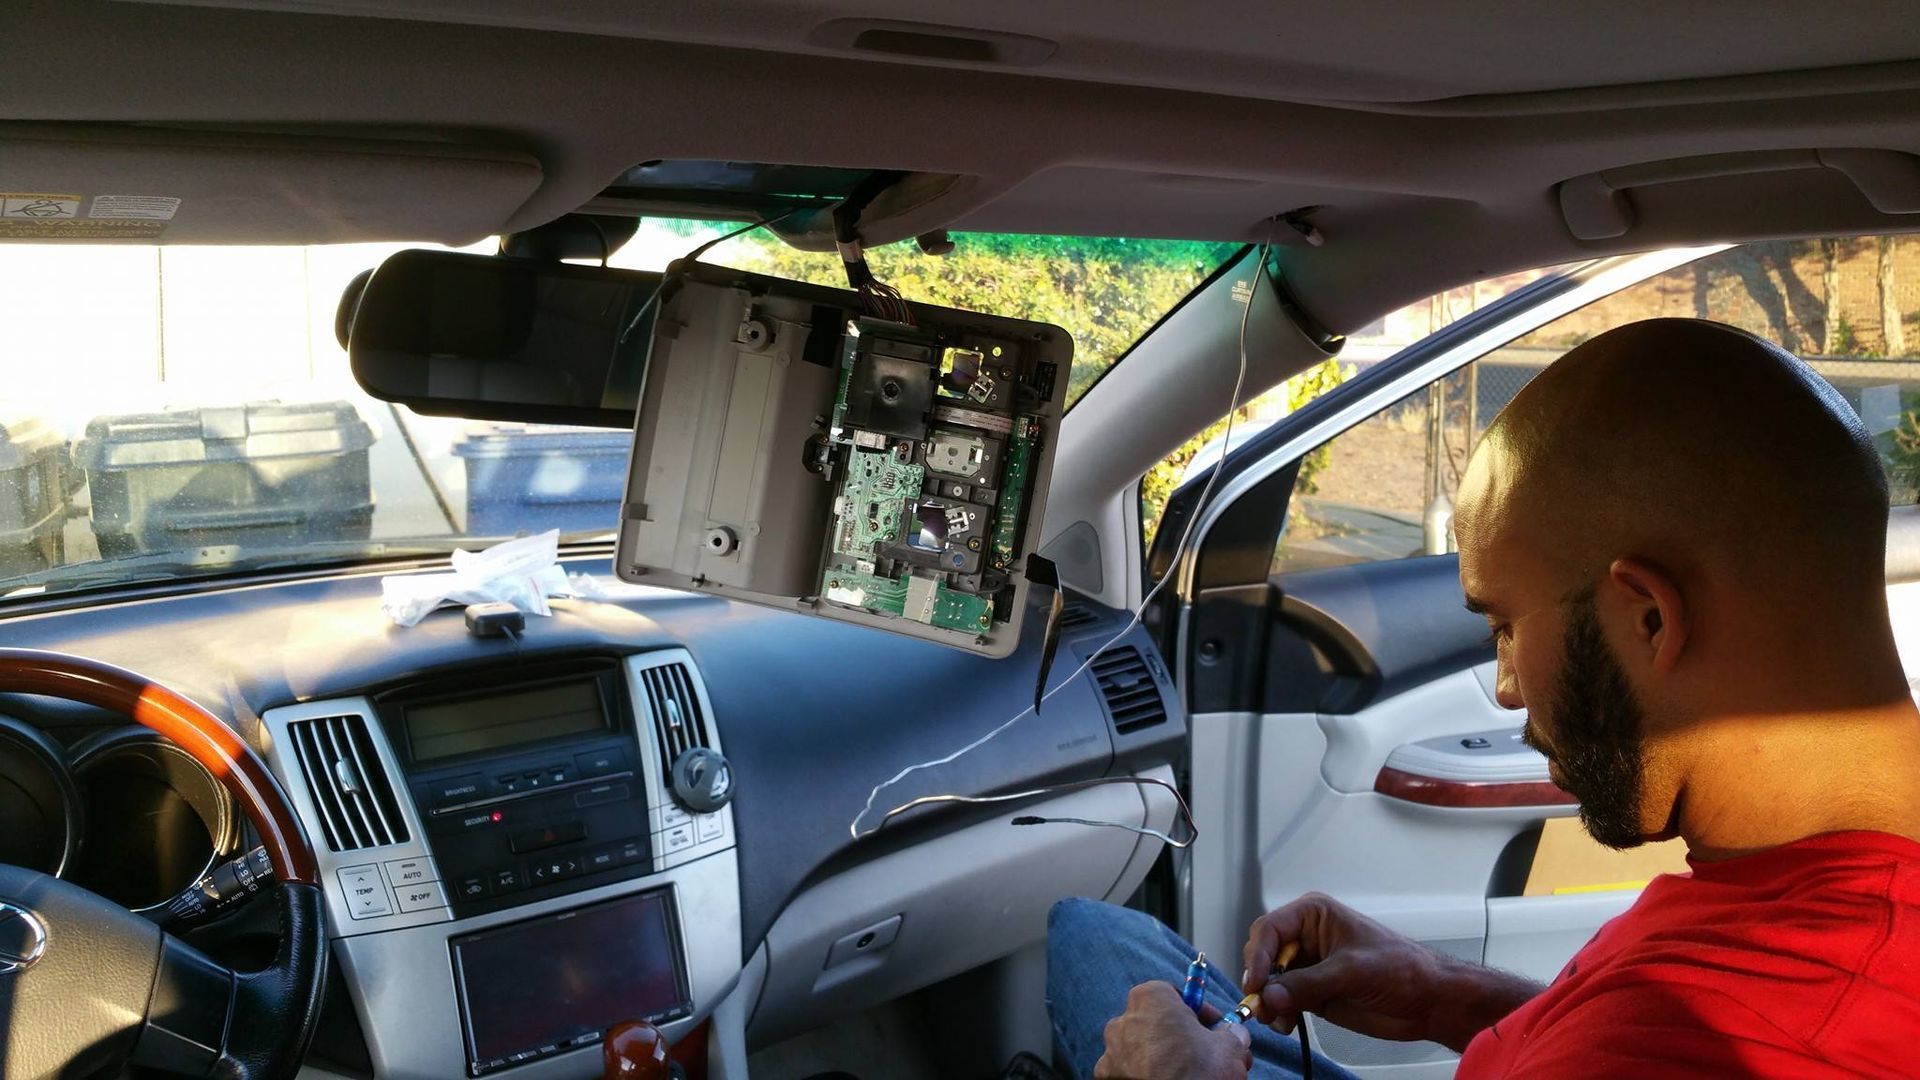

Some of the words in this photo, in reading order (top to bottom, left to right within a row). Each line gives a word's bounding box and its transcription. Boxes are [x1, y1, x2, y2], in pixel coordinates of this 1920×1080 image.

[403, 871, 422, 880] AUTO
[242, 875, 255, 886] OFF
[500, 876, 514, 886] A/C
[231, 891, 245, 901] AUTO
[355, 887, 374, 896] TEMP
[418, 892, 431, 900] OFF
